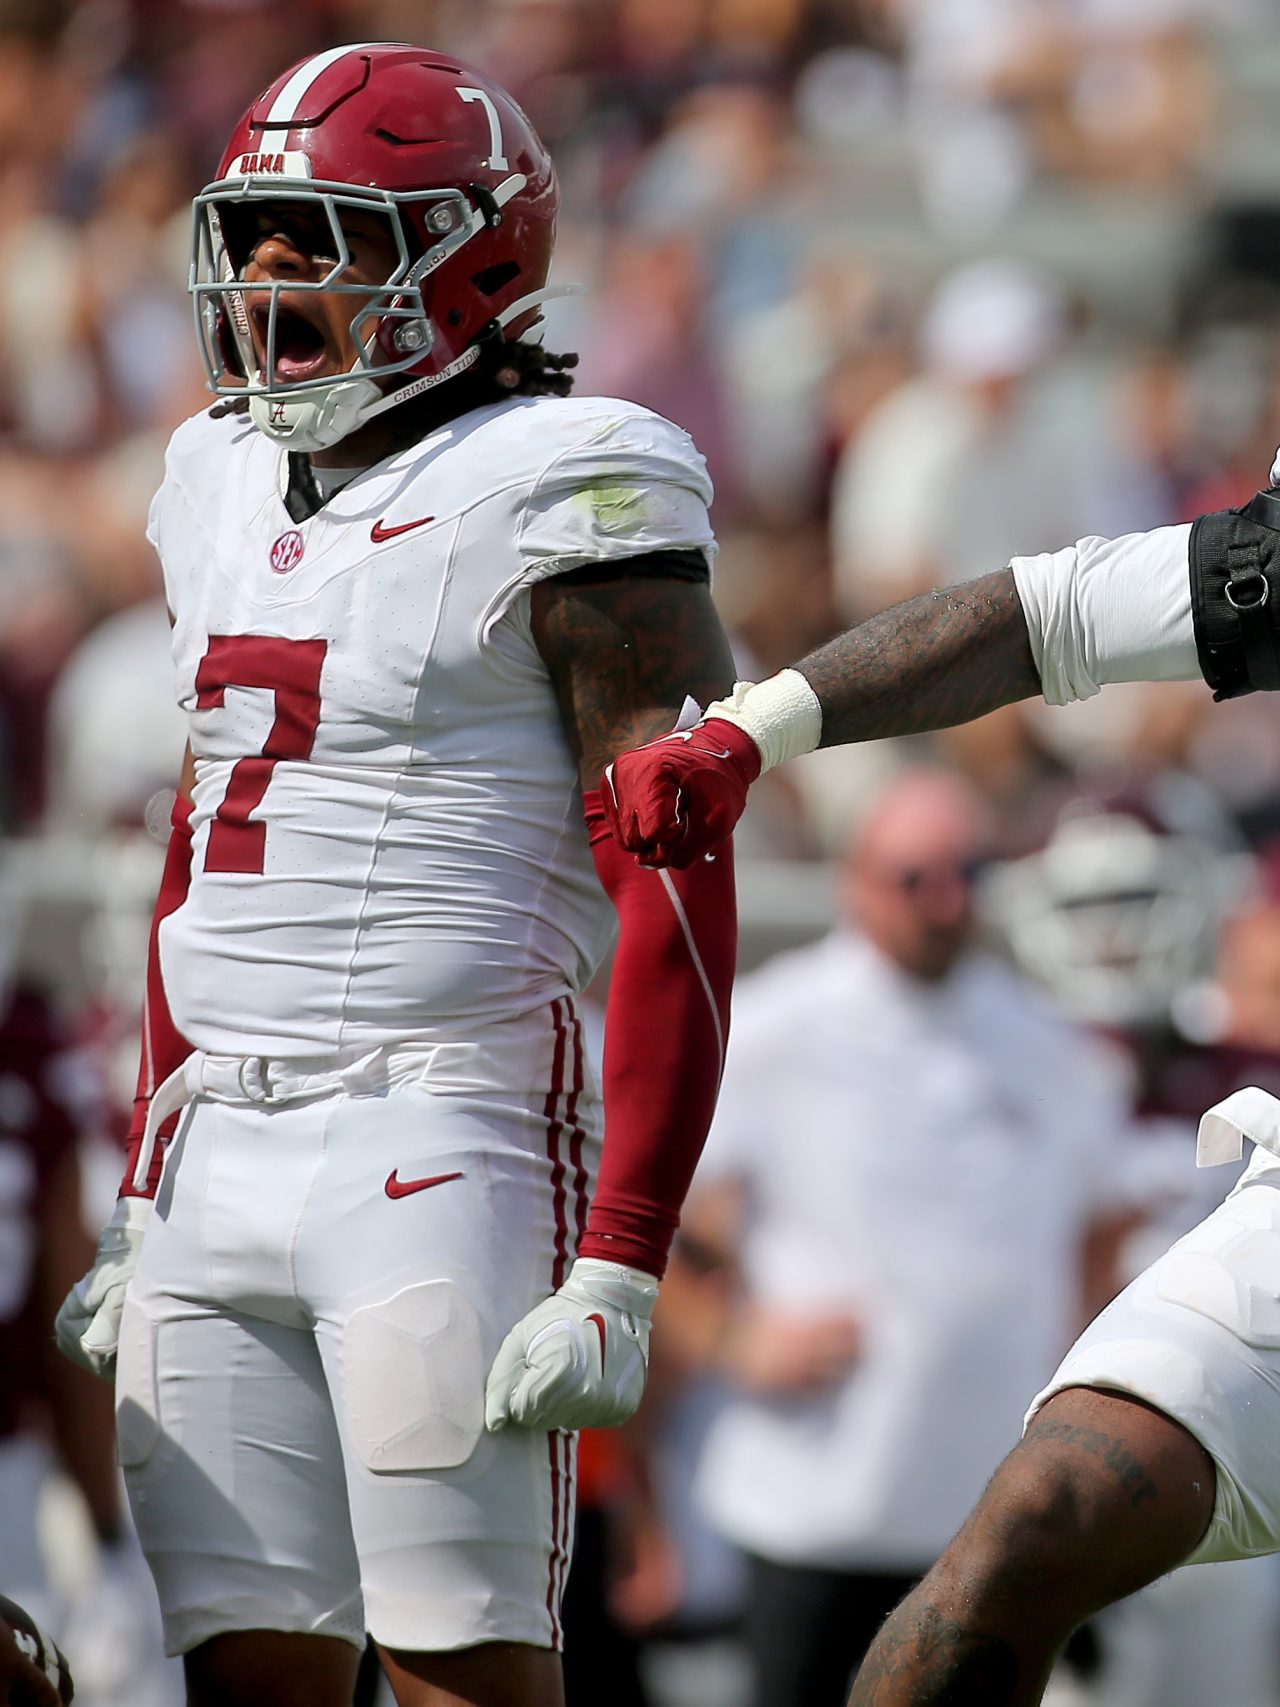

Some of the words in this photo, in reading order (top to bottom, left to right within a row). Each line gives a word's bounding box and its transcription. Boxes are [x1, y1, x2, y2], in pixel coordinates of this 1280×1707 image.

[455, 86, 509, 171] 7
[240, 154, 285, 173] BAMA
[394, 367, 452, 403] CRIMSON
[454, 348, 480, 372] TIDE
[271, 531, 303, 573] SEC
[195, 634, 328, 874] 7
